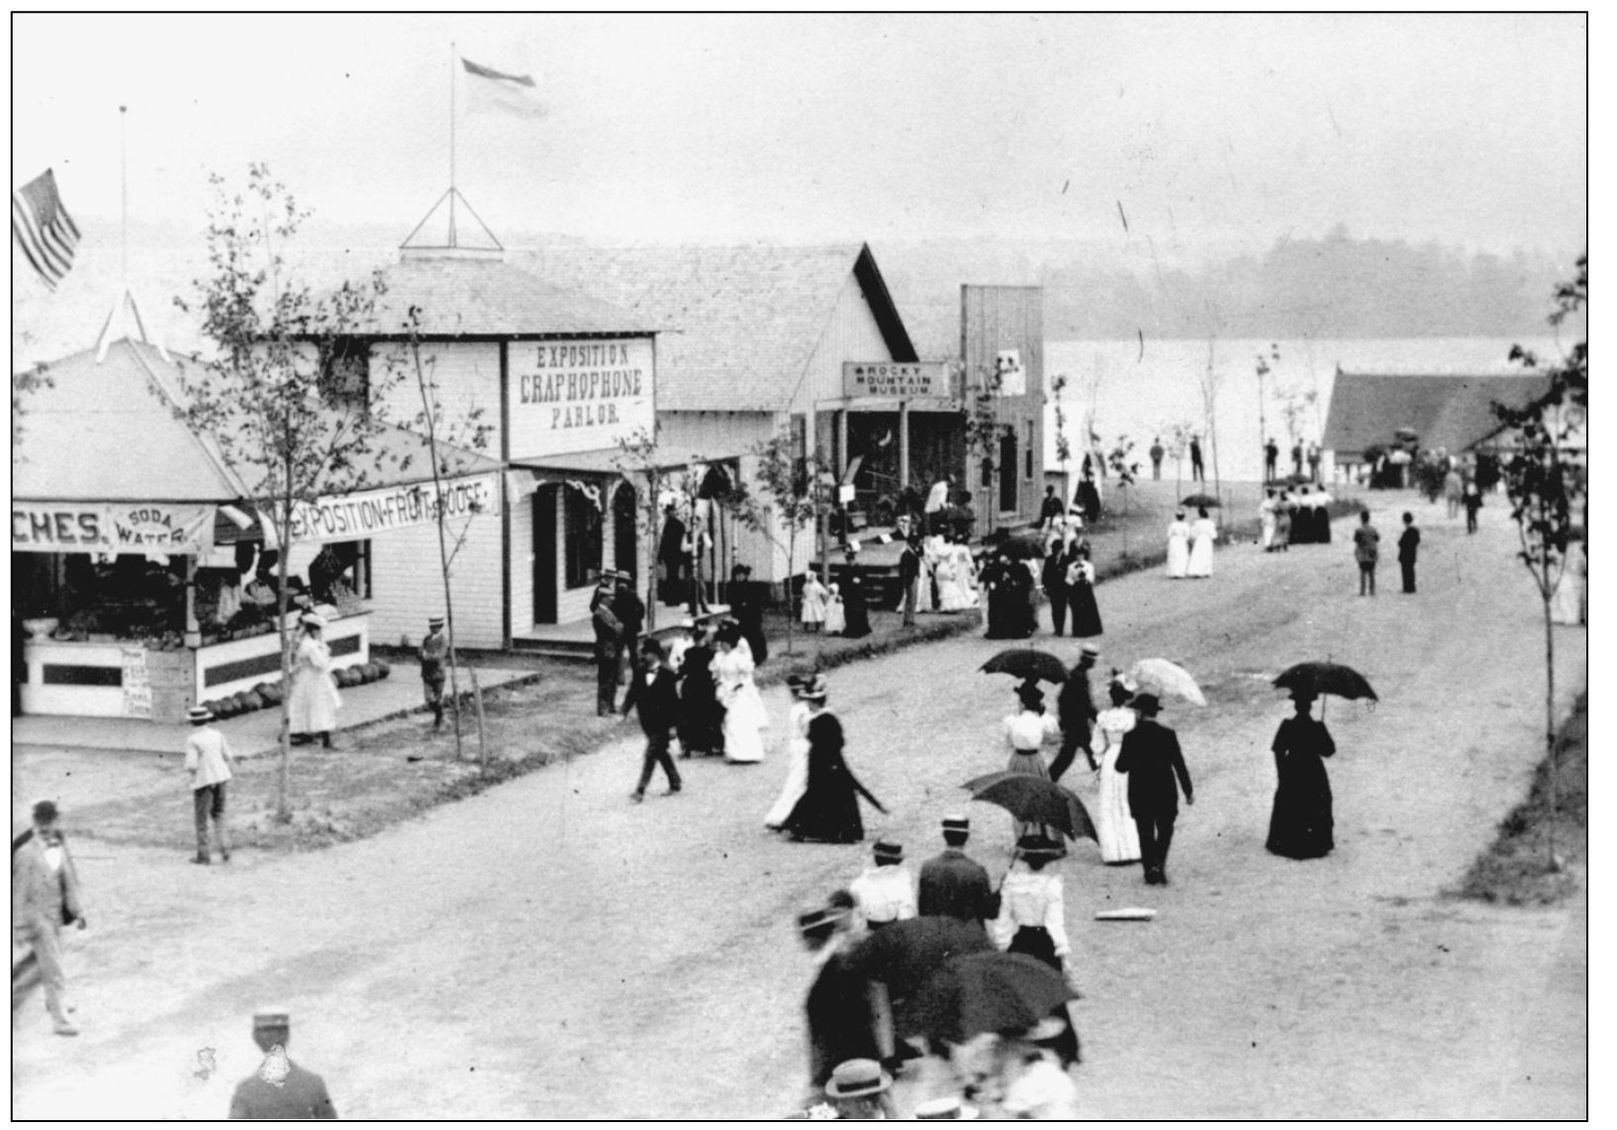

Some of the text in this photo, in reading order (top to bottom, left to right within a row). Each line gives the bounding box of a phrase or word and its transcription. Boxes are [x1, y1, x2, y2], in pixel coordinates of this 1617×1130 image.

[537, 343, 629, 369] EXPOSITION
[867, 366, 920, 376] ROCKY
[857, 376, 931, 385] MOUNTAIN
[128, 508, 172, 529] SODA
